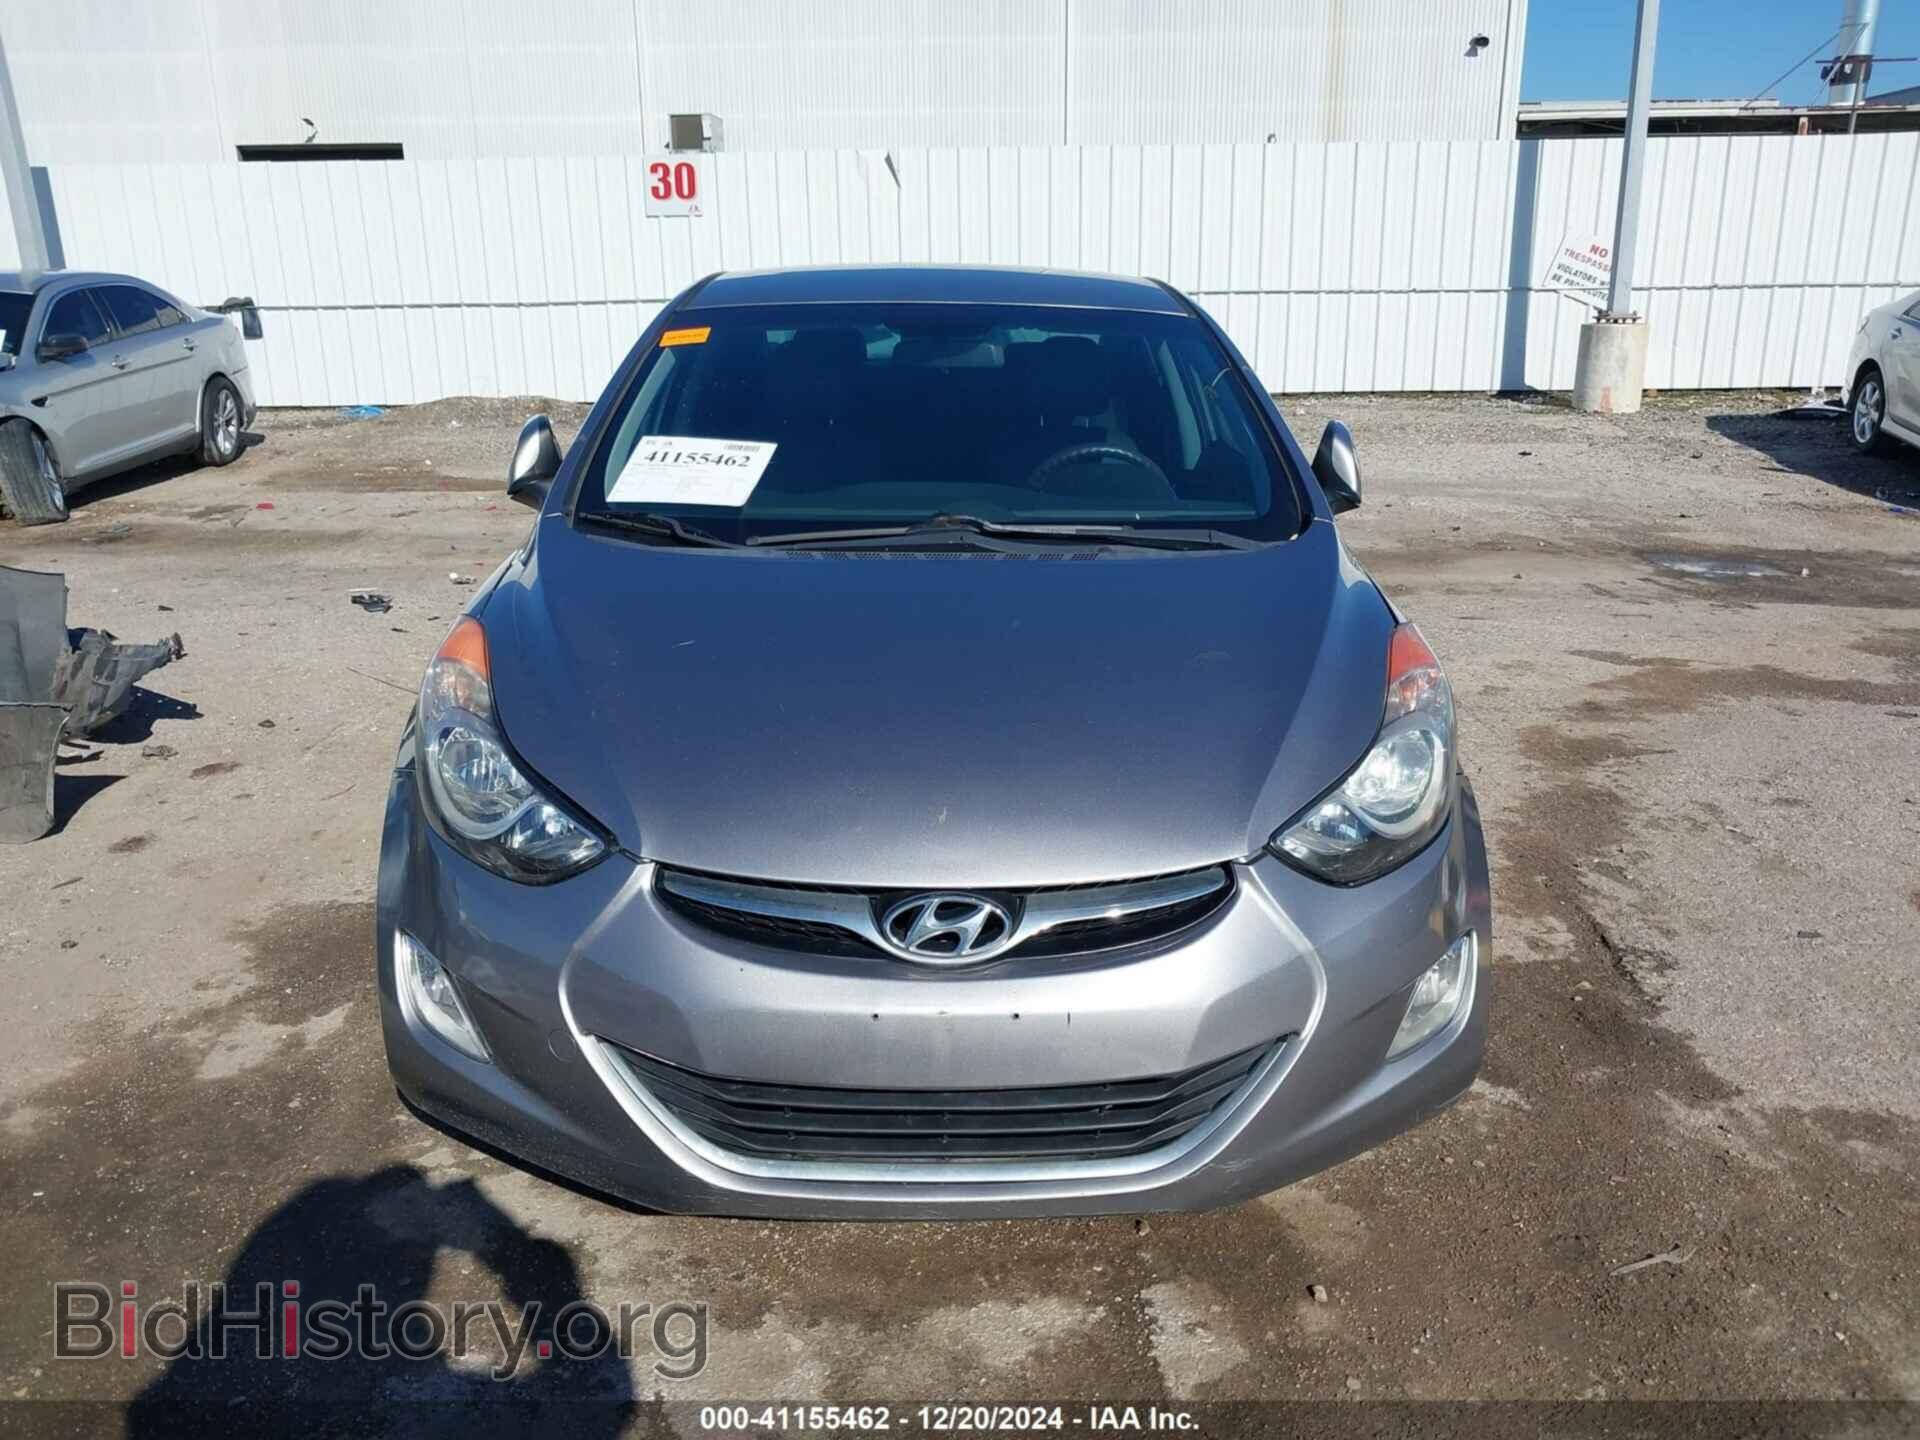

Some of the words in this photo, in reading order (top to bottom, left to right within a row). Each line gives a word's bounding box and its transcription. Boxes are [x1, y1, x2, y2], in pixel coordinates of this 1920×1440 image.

[649, 162, 697, 200] 30
[1590, 244, 1609, 258] NO
[1551, 273, 1563, 283] BE
[1557, 263, 1598, 284] VIOLATORS
[643, 450, 751, 468] 41155462
